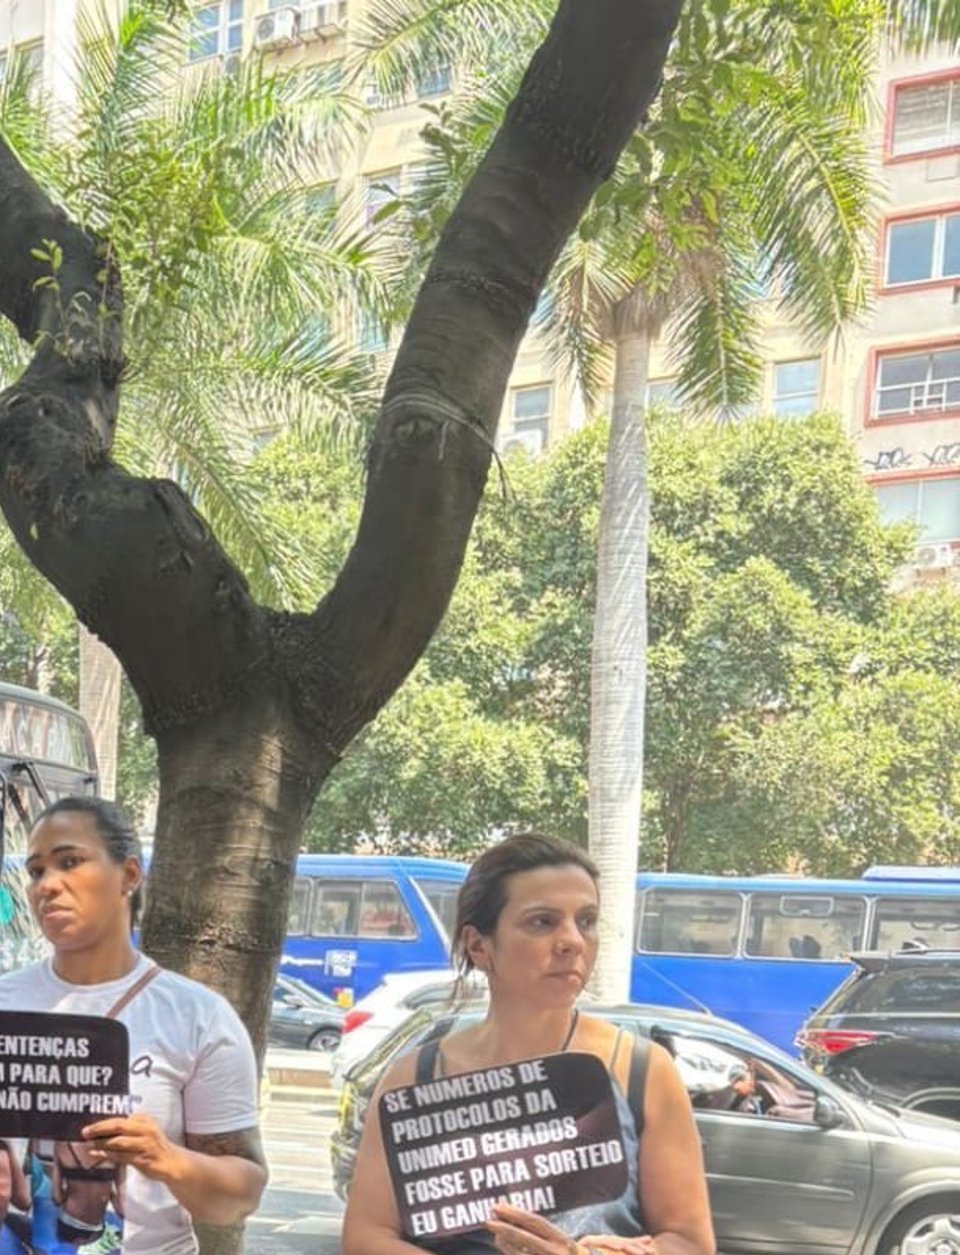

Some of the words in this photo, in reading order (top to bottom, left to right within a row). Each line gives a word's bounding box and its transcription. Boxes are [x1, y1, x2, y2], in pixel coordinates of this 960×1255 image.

[9, 1063, 61, 1085] PARA
[67, 1066, 113, 1088] QUE?
[384, 1089, 411, 1113] SE
[414, 1068, 515, 1106] NUMEROS
[518, 1059, 549, 1083] DE
[392, 1096, 521, 1144] PROTOCOLOS
[525, 1088, 558, 1114] DA
[398, 1137, 477, 1175] UNIMED
[480, 1116, 579, 1156] GERADOS
[404, 1171, 468, 1205] FOSSE
[470, 1158, 531, 1190] PARA
[534, 1139, 623, 1178] SORTEIO
[411, 1209, 438, 1236] EU
